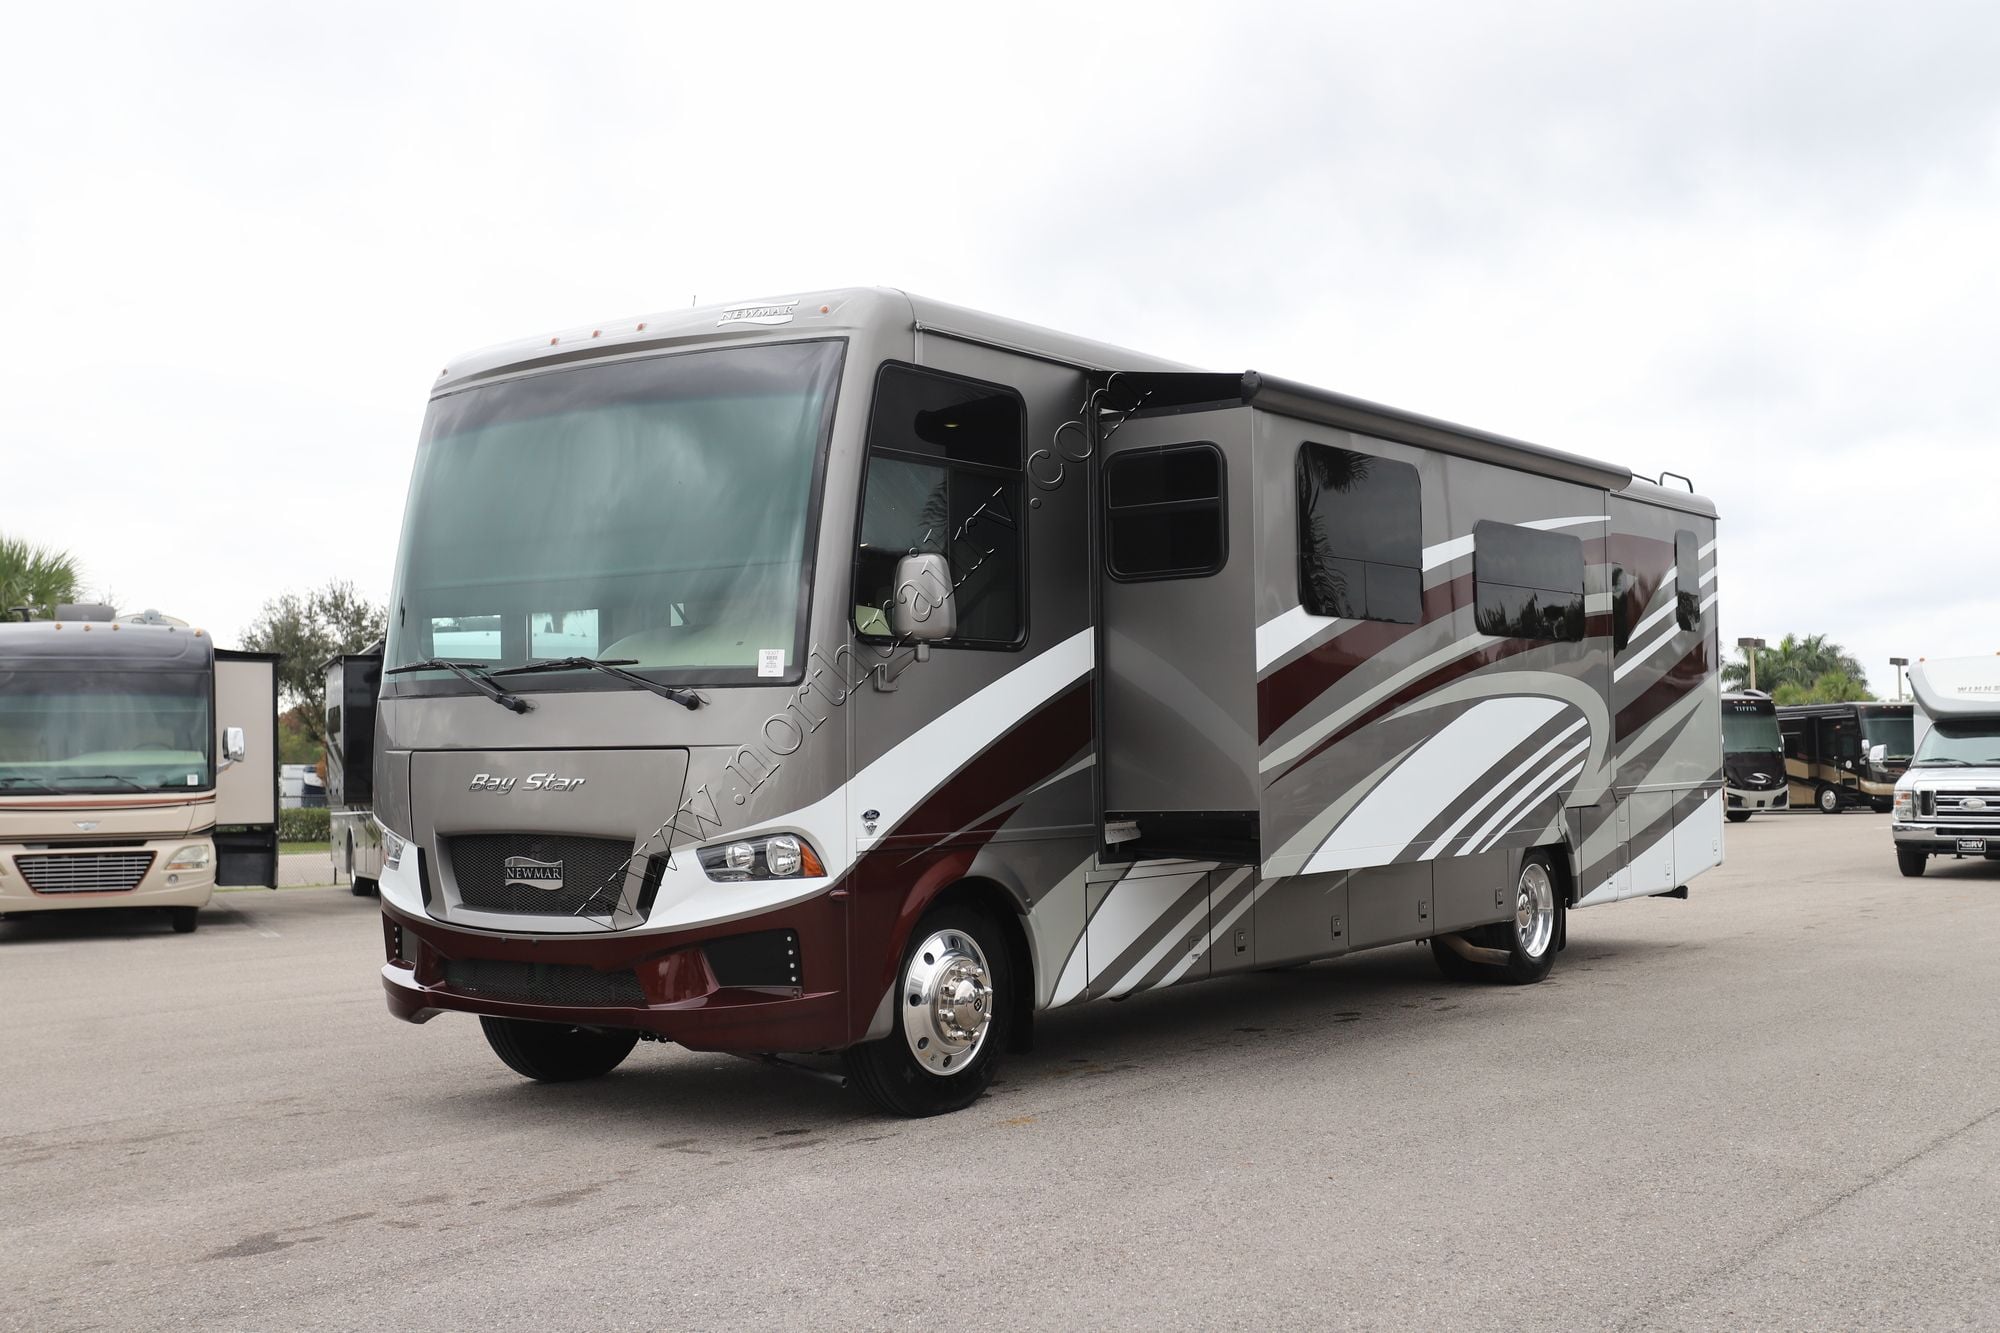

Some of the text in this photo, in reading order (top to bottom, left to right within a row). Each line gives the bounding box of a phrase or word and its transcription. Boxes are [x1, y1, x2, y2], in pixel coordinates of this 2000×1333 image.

[720, 305, 793, 321] NEWMAR
[468, 773, 586, 796] Bay Star
[506, 867, 561, 879] NEWMAR
